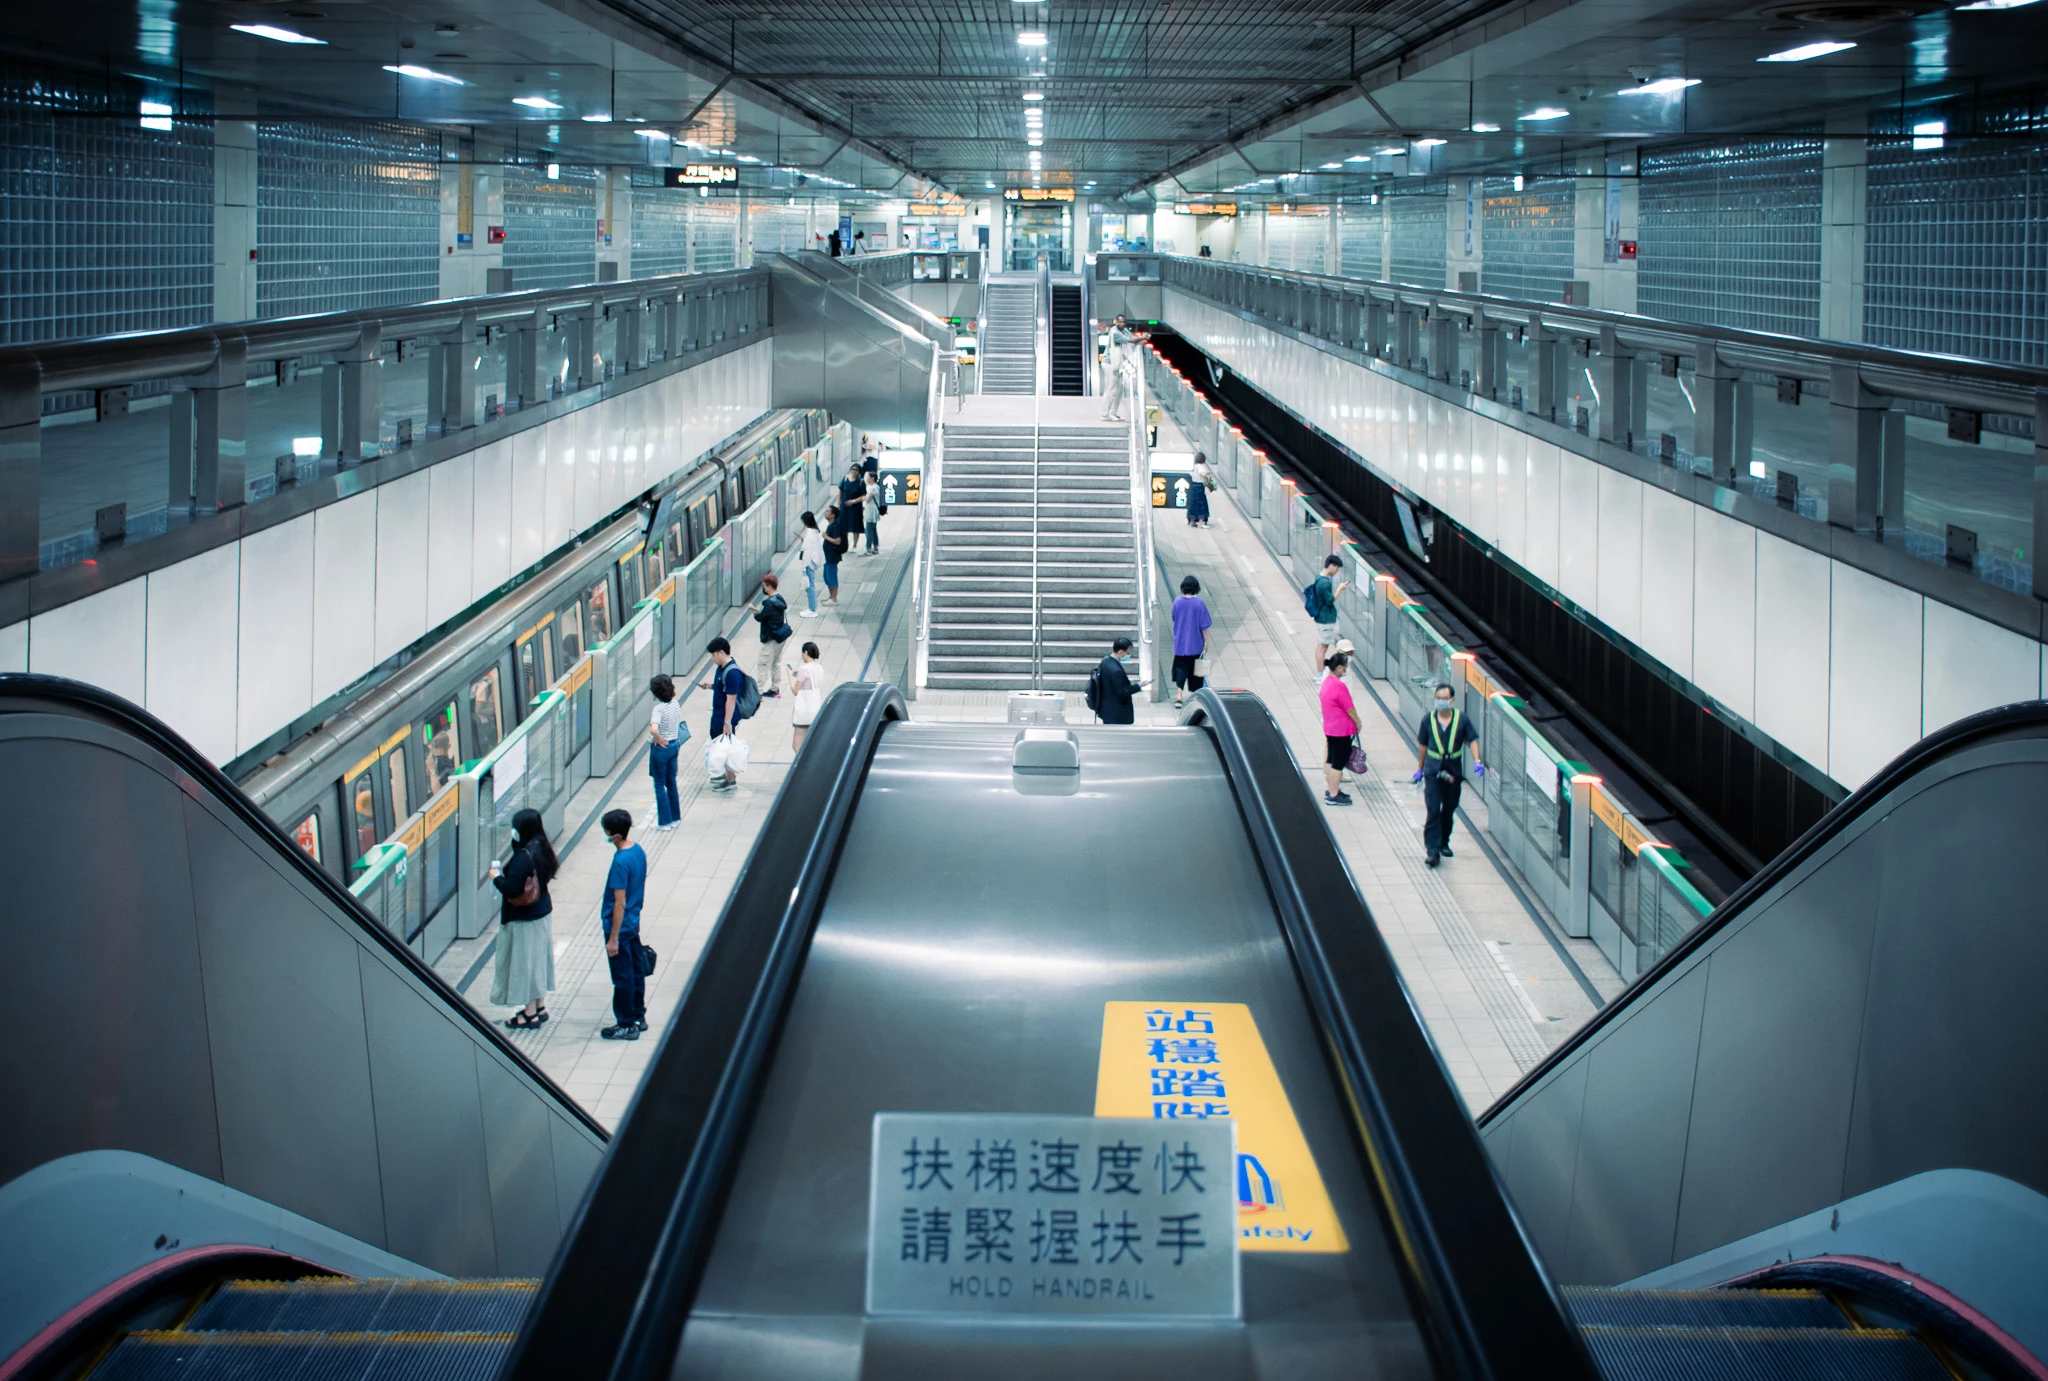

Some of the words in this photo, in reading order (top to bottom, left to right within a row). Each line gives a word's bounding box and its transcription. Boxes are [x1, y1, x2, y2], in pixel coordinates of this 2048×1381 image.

[901, 1137, 1206, 1195] 扶梯速度快
[900, 1206, 1206, 1266] 請緊握扶手
[1239, 1224, 1314, 1242] afely
[949, 1275, 1013, 1297] HOLD
[1032, 1277, 1154, 1299] HANDRAIL
